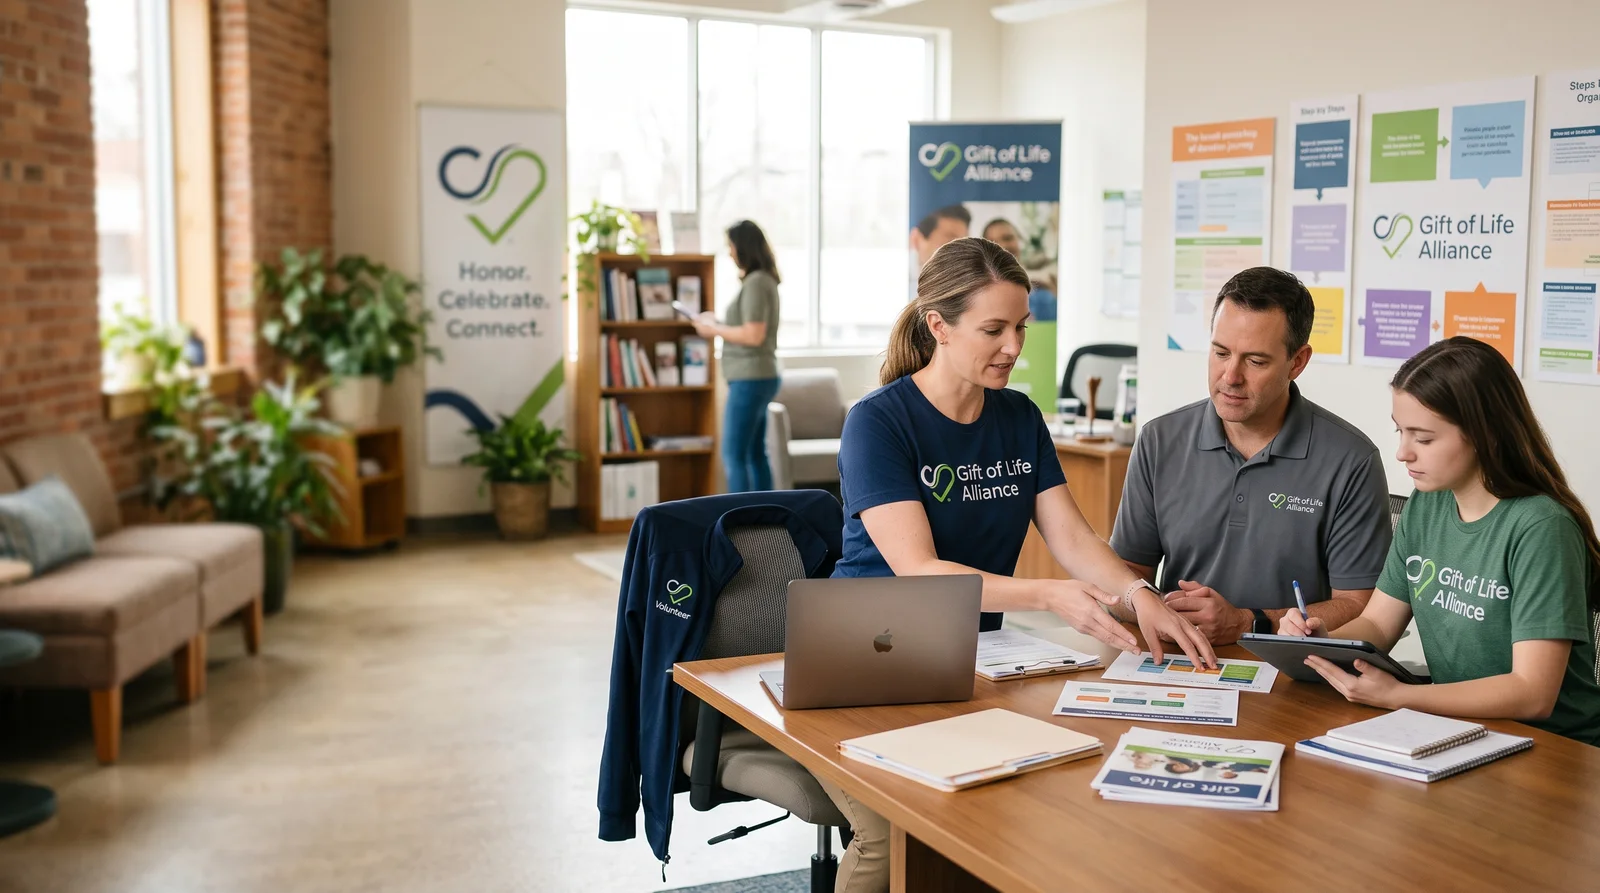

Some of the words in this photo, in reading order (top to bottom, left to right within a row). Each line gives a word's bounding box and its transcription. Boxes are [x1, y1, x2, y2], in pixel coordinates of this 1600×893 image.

[1569, 81, 1596, 91] Steps
[1576, 93, 1600, 104] Orga
[964, 144, 997, 163] Gift
[998, 144, 1018, 163] of
[1018, 144, 1051, 163] Life
[964, 164, 1033, 182] Alliance
[1419, 215, 1453, 235] Gift
[1456, 214, 1477, 234] of
[1480, 213, 1515, 234] Life
[1418, 239, 1493, 260] Alliance
[458, 262, 532, 281] Honor.
[438, 289, 551, 310] Celebrate.
[446, 318, 544, 339] Connect.
[956, 463, 984, 481] Gift
[986, 461, 1003, 479] of
[1005, 458, 1032, 477] Life
[962, 483, 1020, 502] Alliance
[1286, 495, 1301, 504] Gift
[1301, 497, 1310, 505] of
[1310, 498, 1324, 507] Life
[1286, 503, 1315, 513] Alliance
[1438, 567, 1464, 590] Gift
[1464, 575, 1479, 594] of
[1477, 577, 1510, 600] Life
[655, 600, 691, 620] Volunteer
[1430, 589, 1485, 622] Alliance
[1129, 775, 1169, 788] Life
[1171, 781, 1196, 789] of
[1200, 784, 1241, 794] Gift
